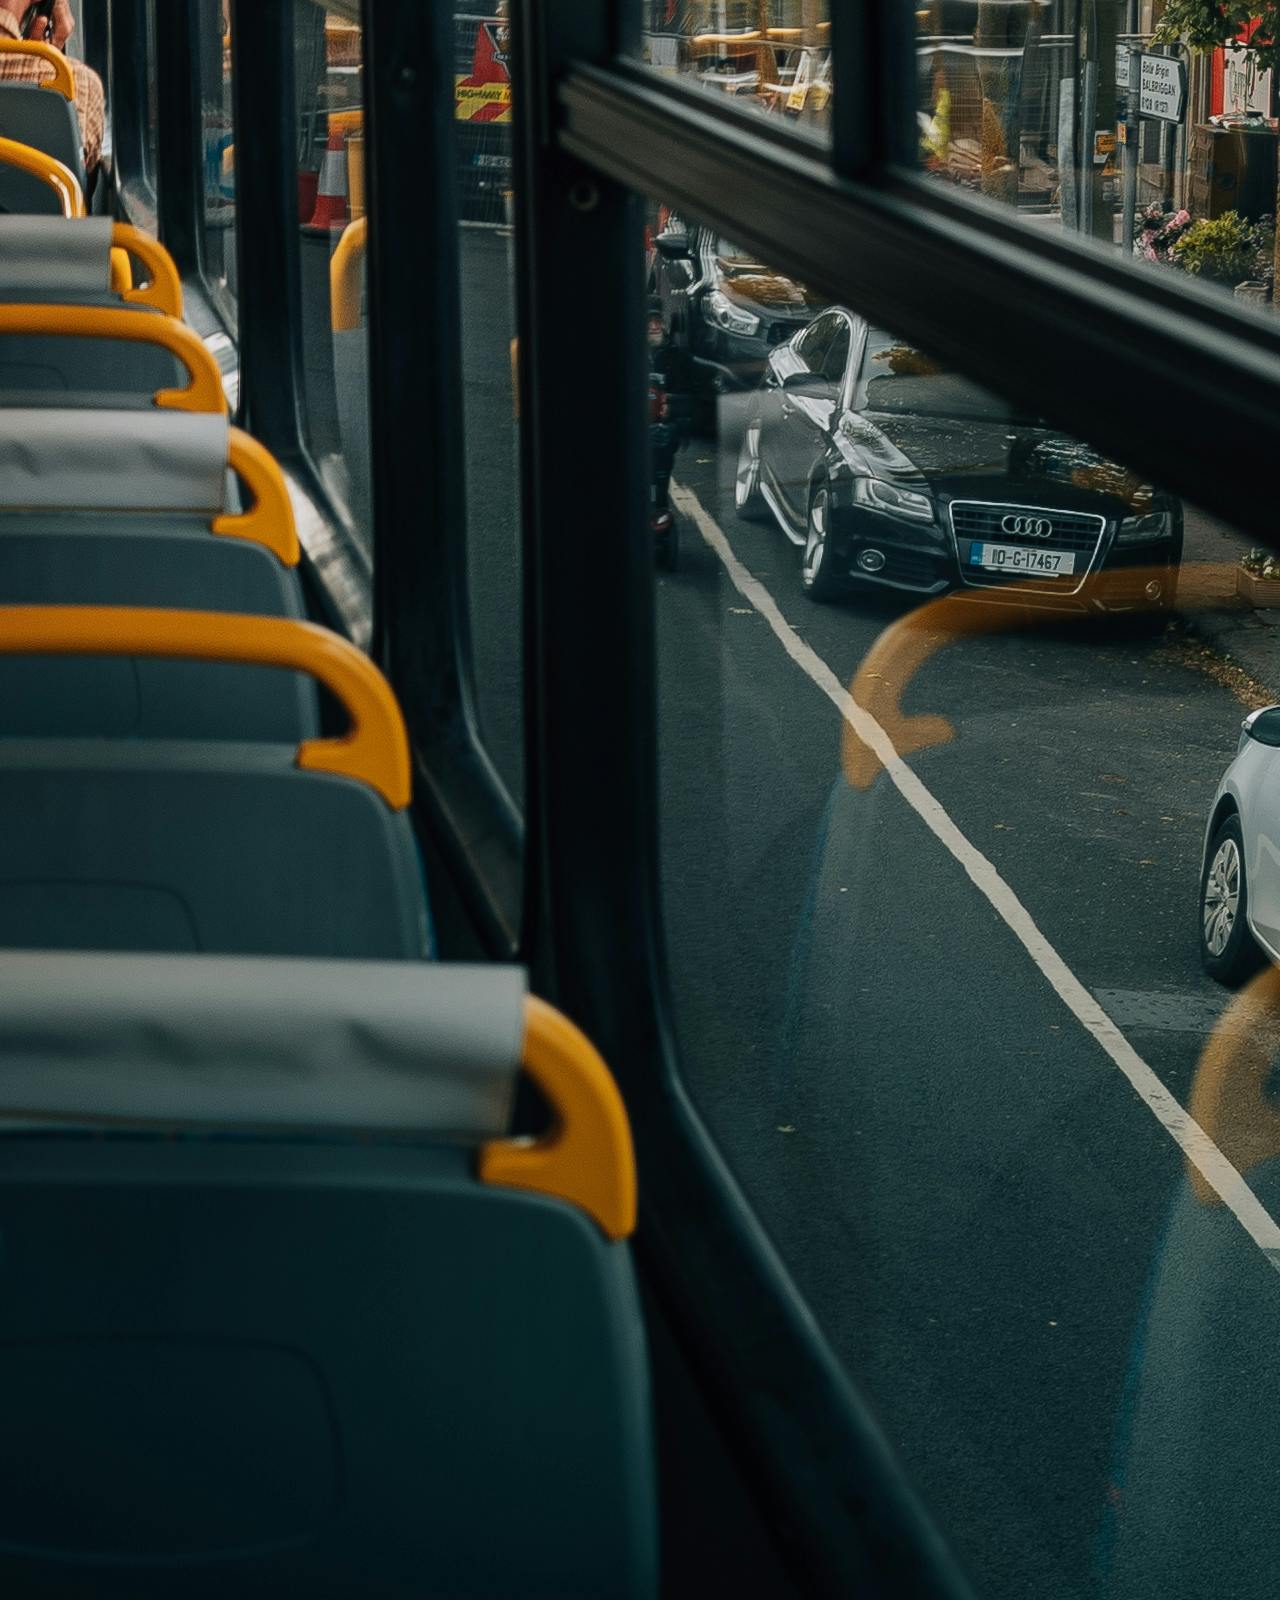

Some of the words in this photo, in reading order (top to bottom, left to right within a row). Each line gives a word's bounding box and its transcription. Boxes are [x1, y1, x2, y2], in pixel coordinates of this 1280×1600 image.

[456, 89, 501, 100] HIGHWAY
[1142, 78, 1176, 96] BALBRIGGAN
[991, 548, 1062, 570] 10-G-17467
